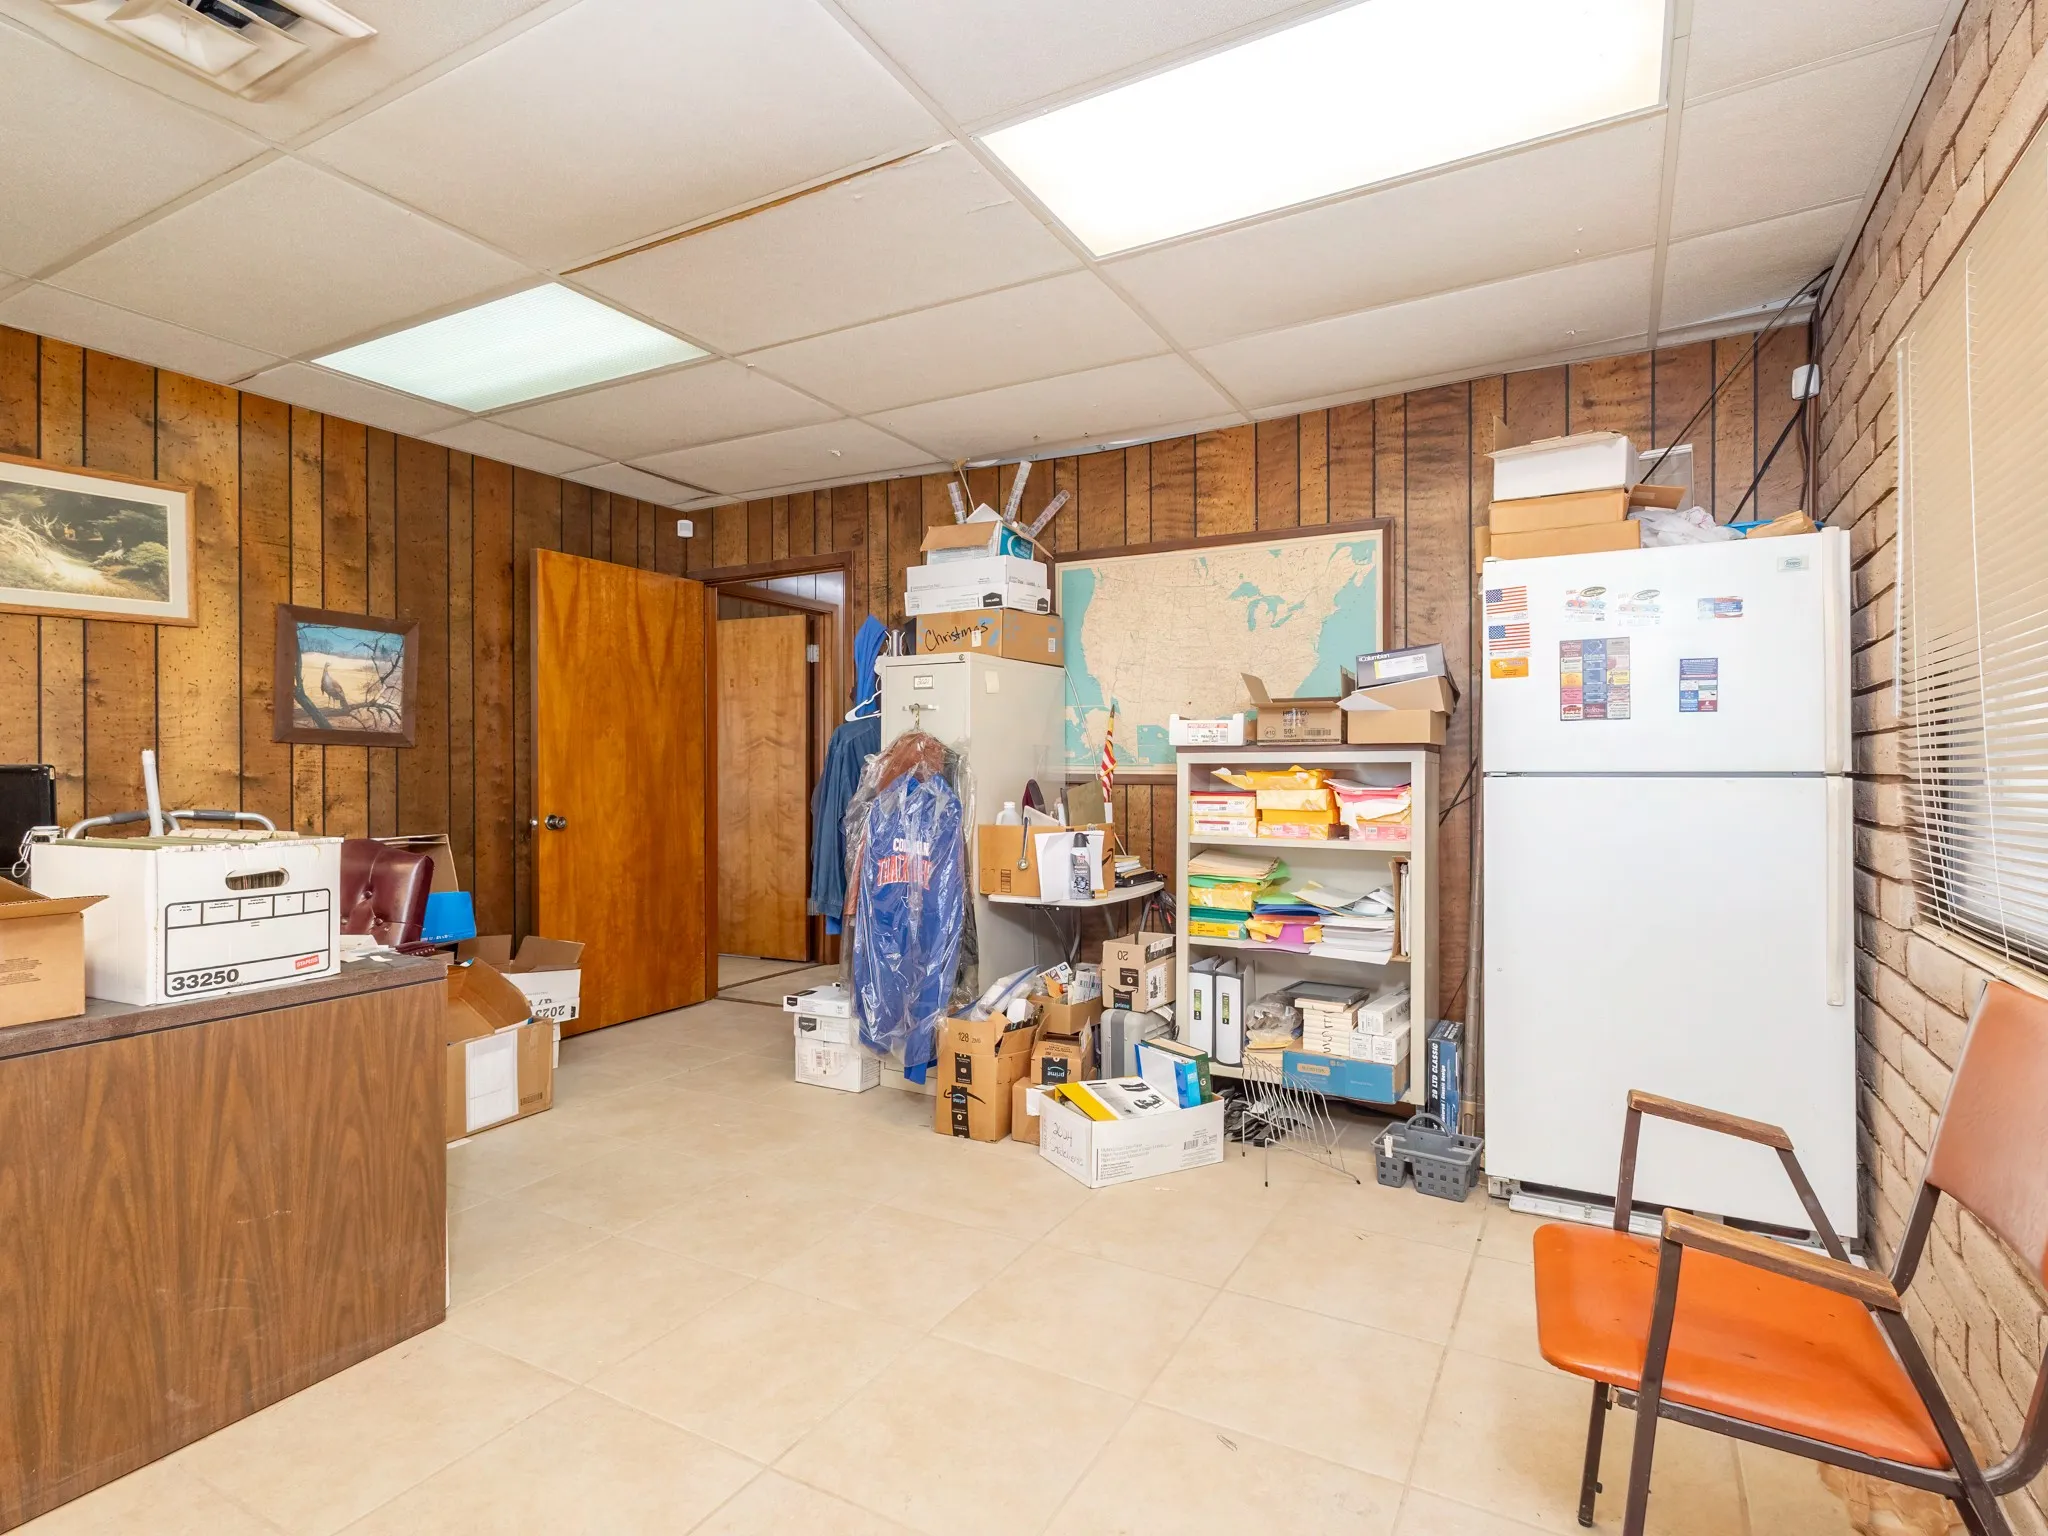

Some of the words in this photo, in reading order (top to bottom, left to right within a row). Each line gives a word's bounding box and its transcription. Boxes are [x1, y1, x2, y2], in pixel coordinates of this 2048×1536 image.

[1360, 653, 1390, 662] Columbian
[171, 968, 240, 992] 33250
[958, 1031, 970, 1043] 128
[1431, 1042, 1439, 1074] CLASSIC
[1047, 1070, 1065, 1078] prime
